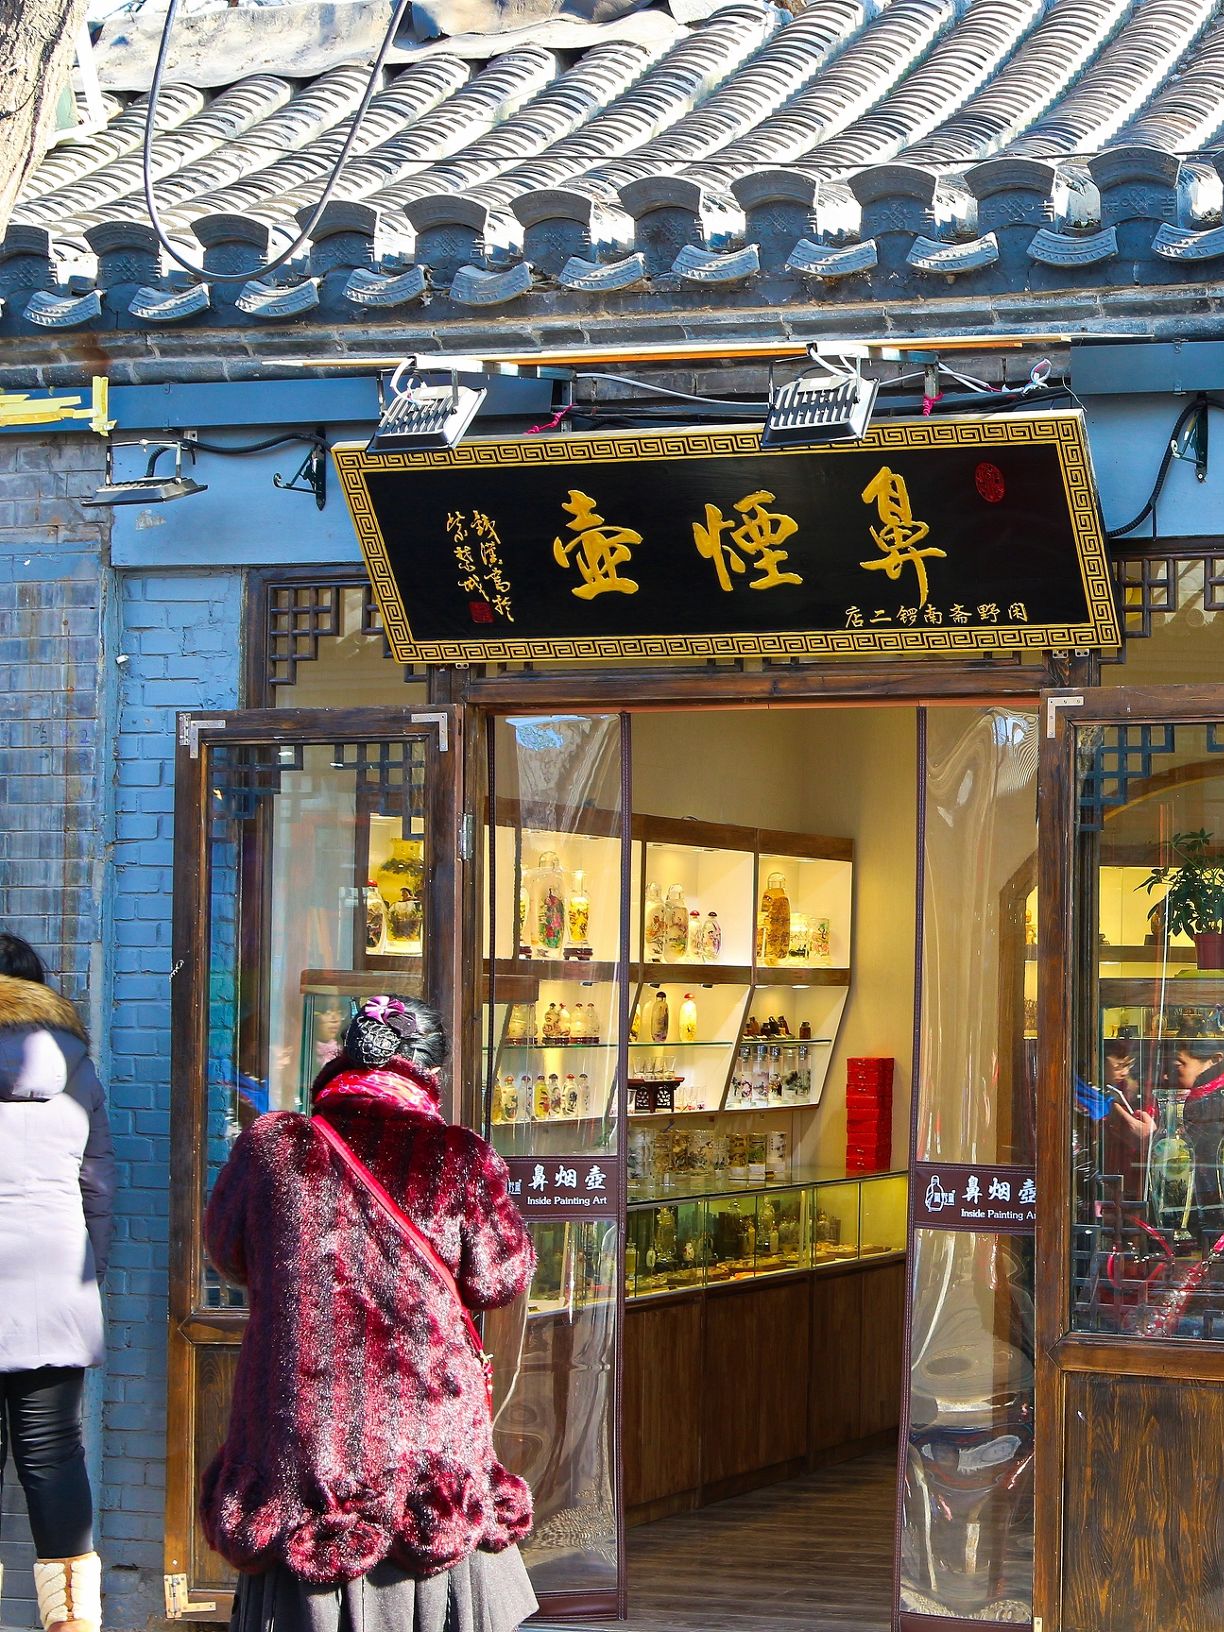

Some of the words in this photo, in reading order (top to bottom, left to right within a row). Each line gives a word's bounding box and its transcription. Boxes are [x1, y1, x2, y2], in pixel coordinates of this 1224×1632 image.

[527, 1196, 551, 1205] Inside
[554, 1196, 590, 1207] Painting
[592, 1195, 607, 1205] Art
[961, 1208, 985, 1218] Inside
[987, 1209, 1023, 1221] Painting
